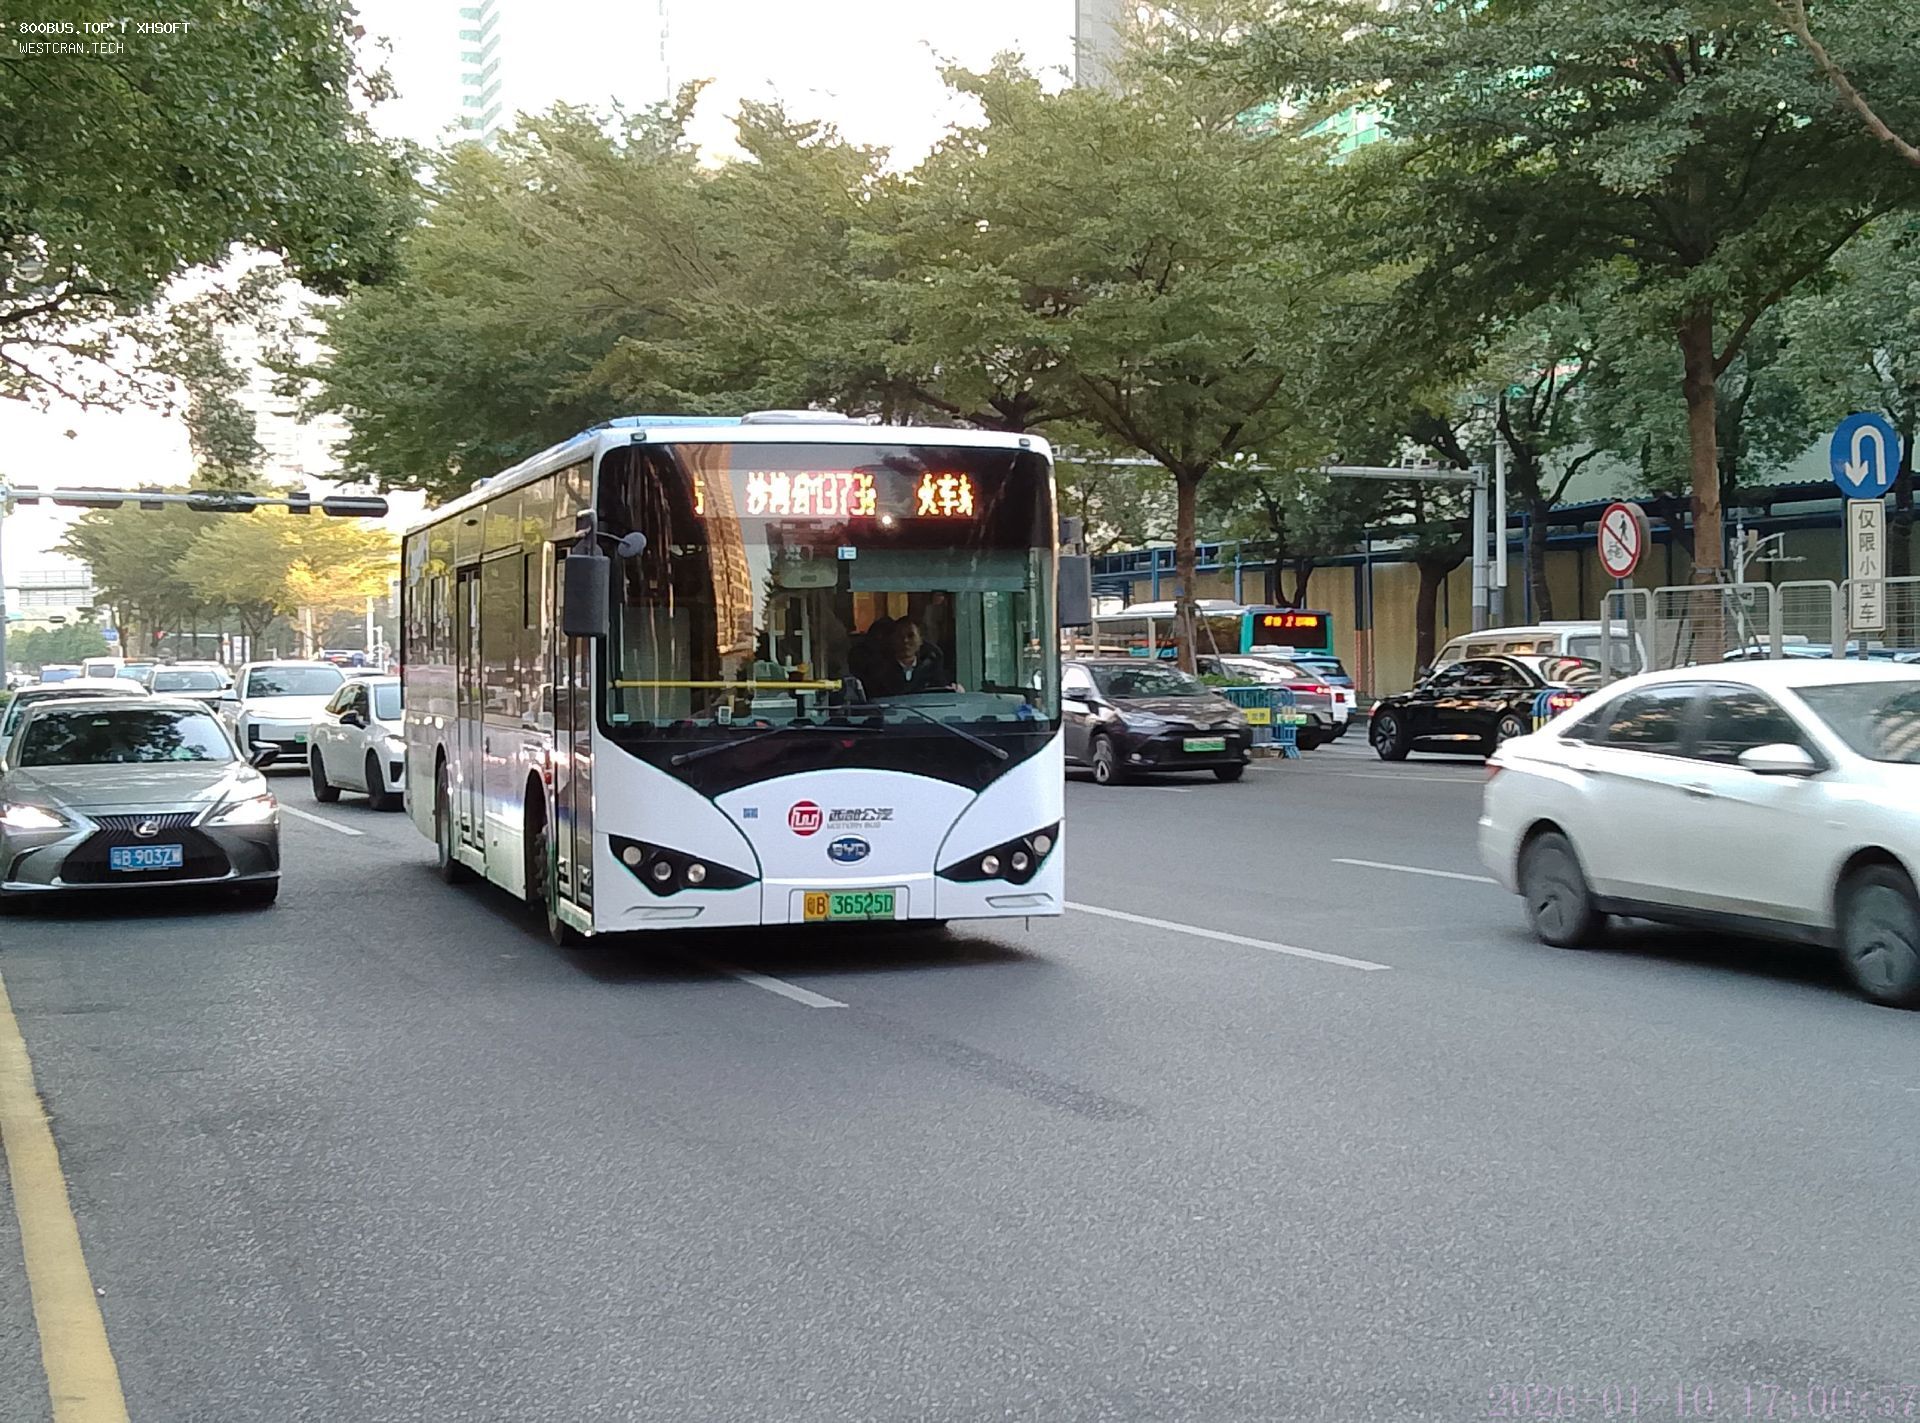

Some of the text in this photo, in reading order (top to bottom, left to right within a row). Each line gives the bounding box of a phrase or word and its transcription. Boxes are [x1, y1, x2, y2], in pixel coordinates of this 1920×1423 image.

[1858, 508, 1877, 624] 仅限小型车
[832, 842, 867, 857] BYD
[833, 893, 894, 915] 36525D
